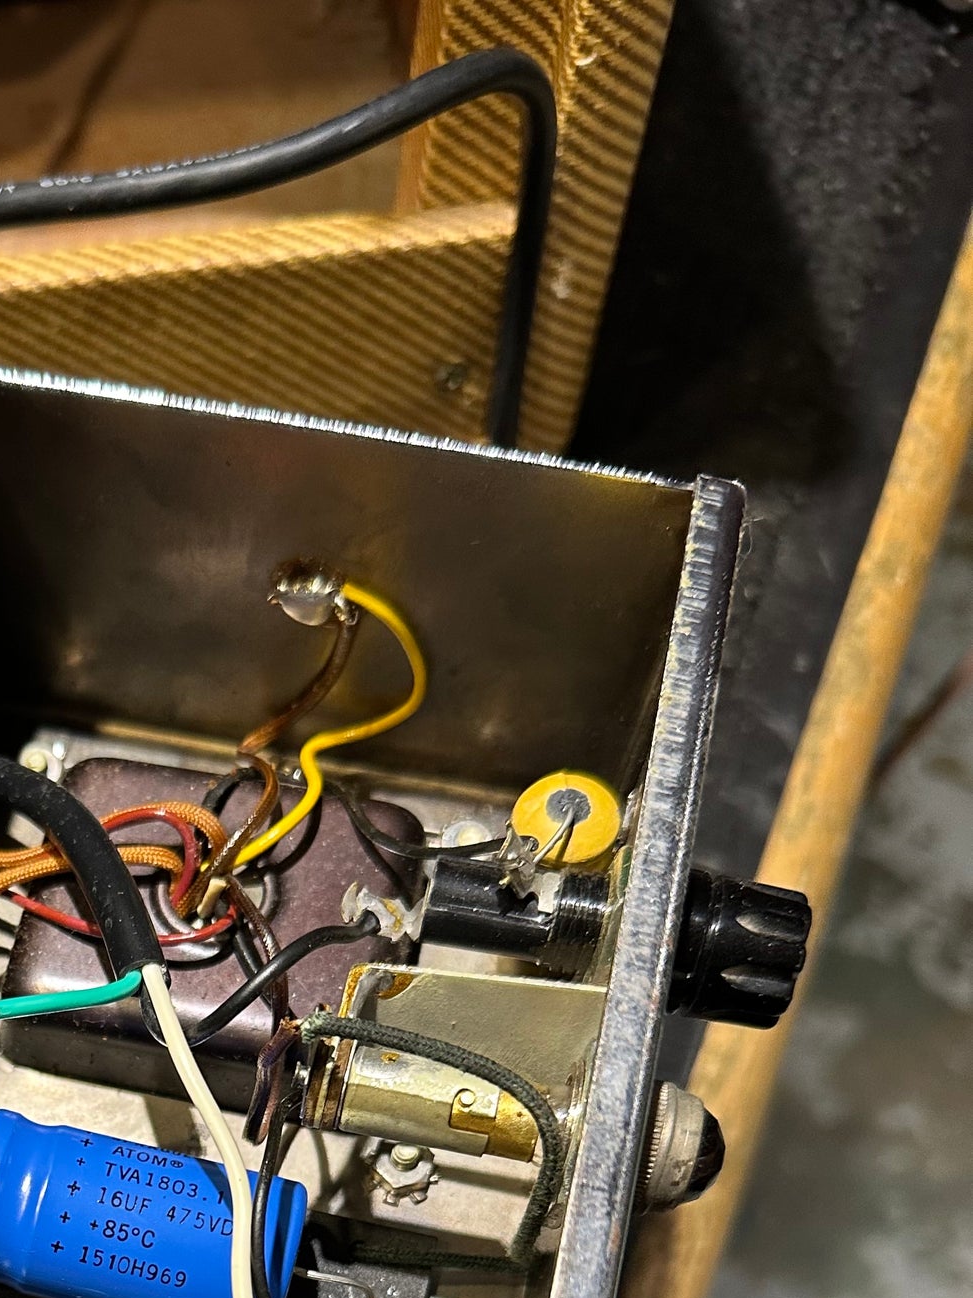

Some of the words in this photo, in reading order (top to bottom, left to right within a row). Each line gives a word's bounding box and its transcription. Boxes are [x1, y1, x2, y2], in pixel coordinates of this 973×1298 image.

[105, 1161, 224, 1205] TVA1803.1
[97, 1187, 152, 1215] 16UF
[166, 1206, 234, 1236] 475VD
